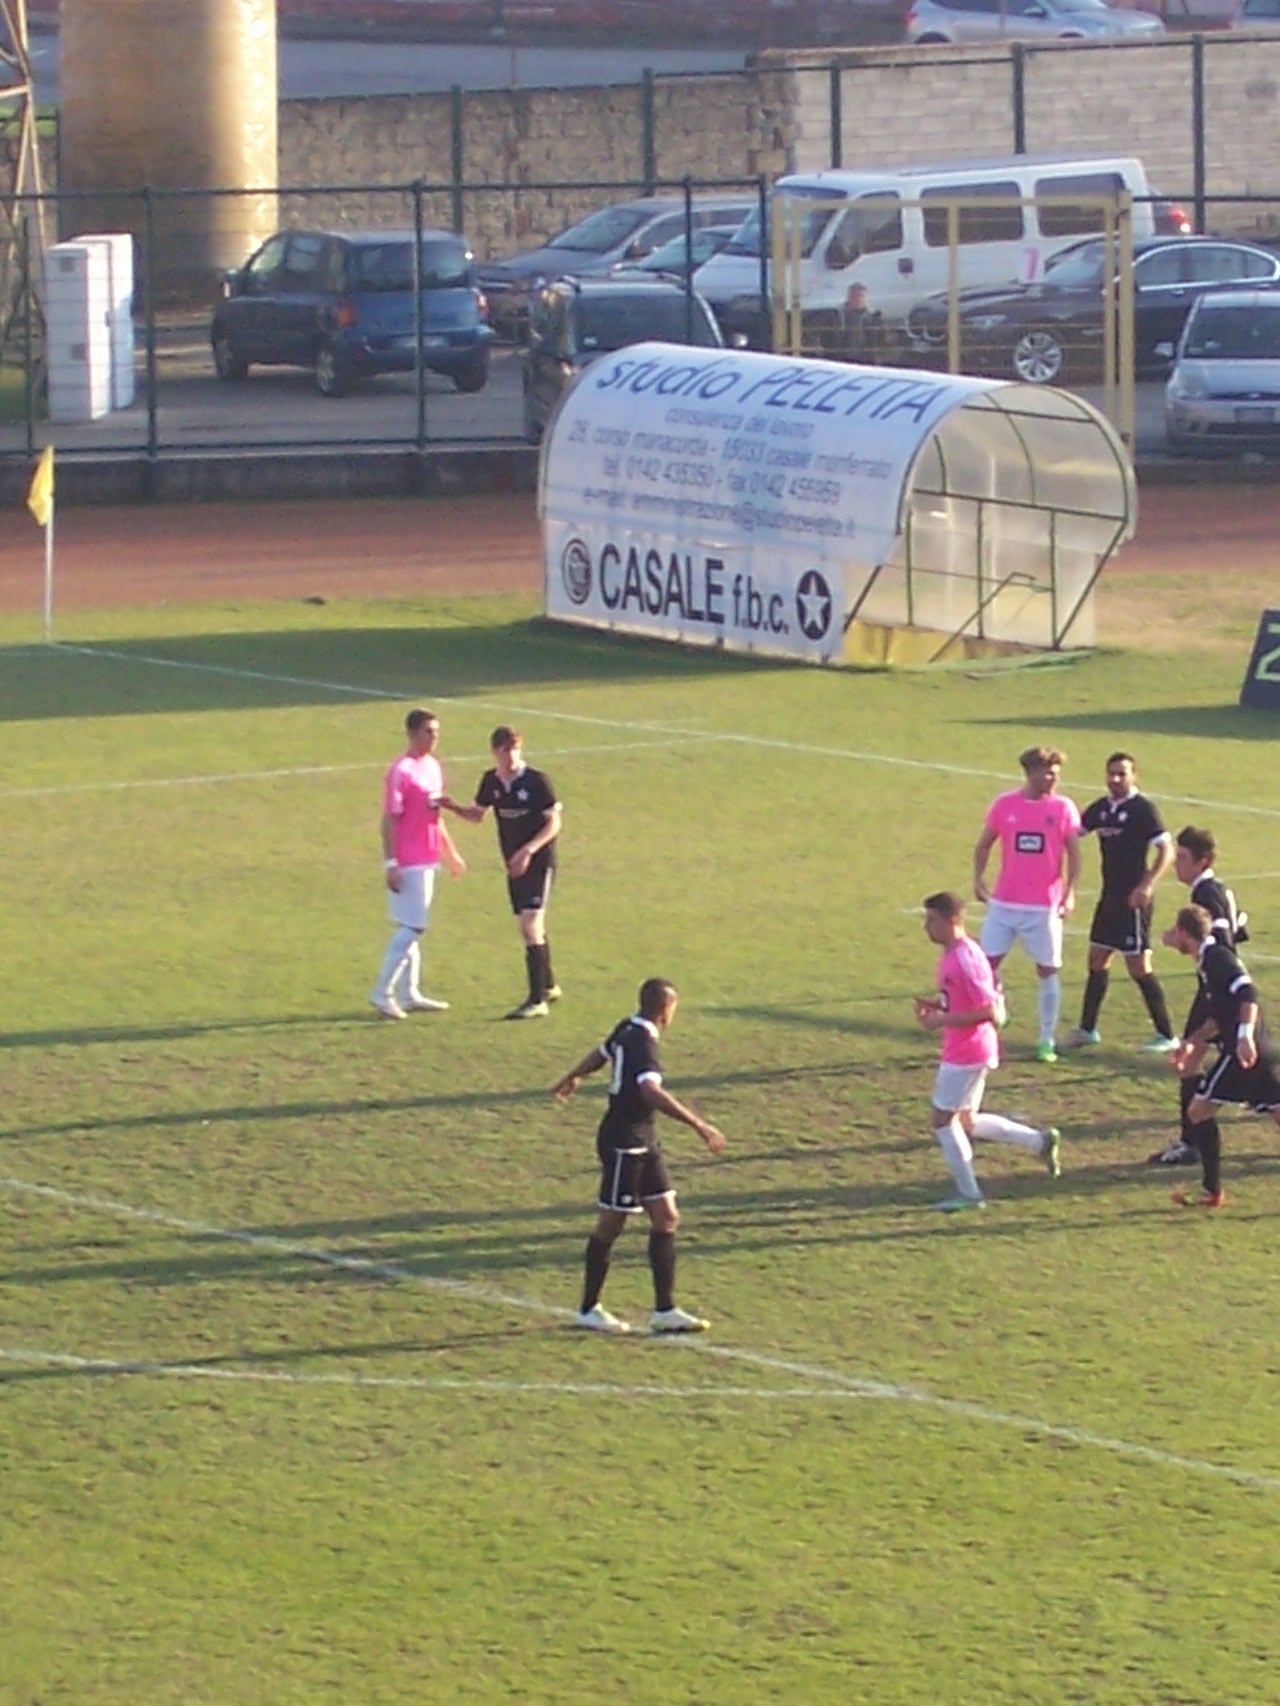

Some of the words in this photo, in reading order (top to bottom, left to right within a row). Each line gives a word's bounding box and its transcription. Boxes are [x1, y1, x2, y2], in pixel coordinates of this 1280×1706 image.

[597, 356, 742, 400] studio
[738, 366, 953, 424] PELETTA
[766, 447, 812, 470] casale
[813, 452, 892, 480] monferrato
[599, 542, 725, 625] CASALE
[732, 574, 790, 635] f.b.c.
